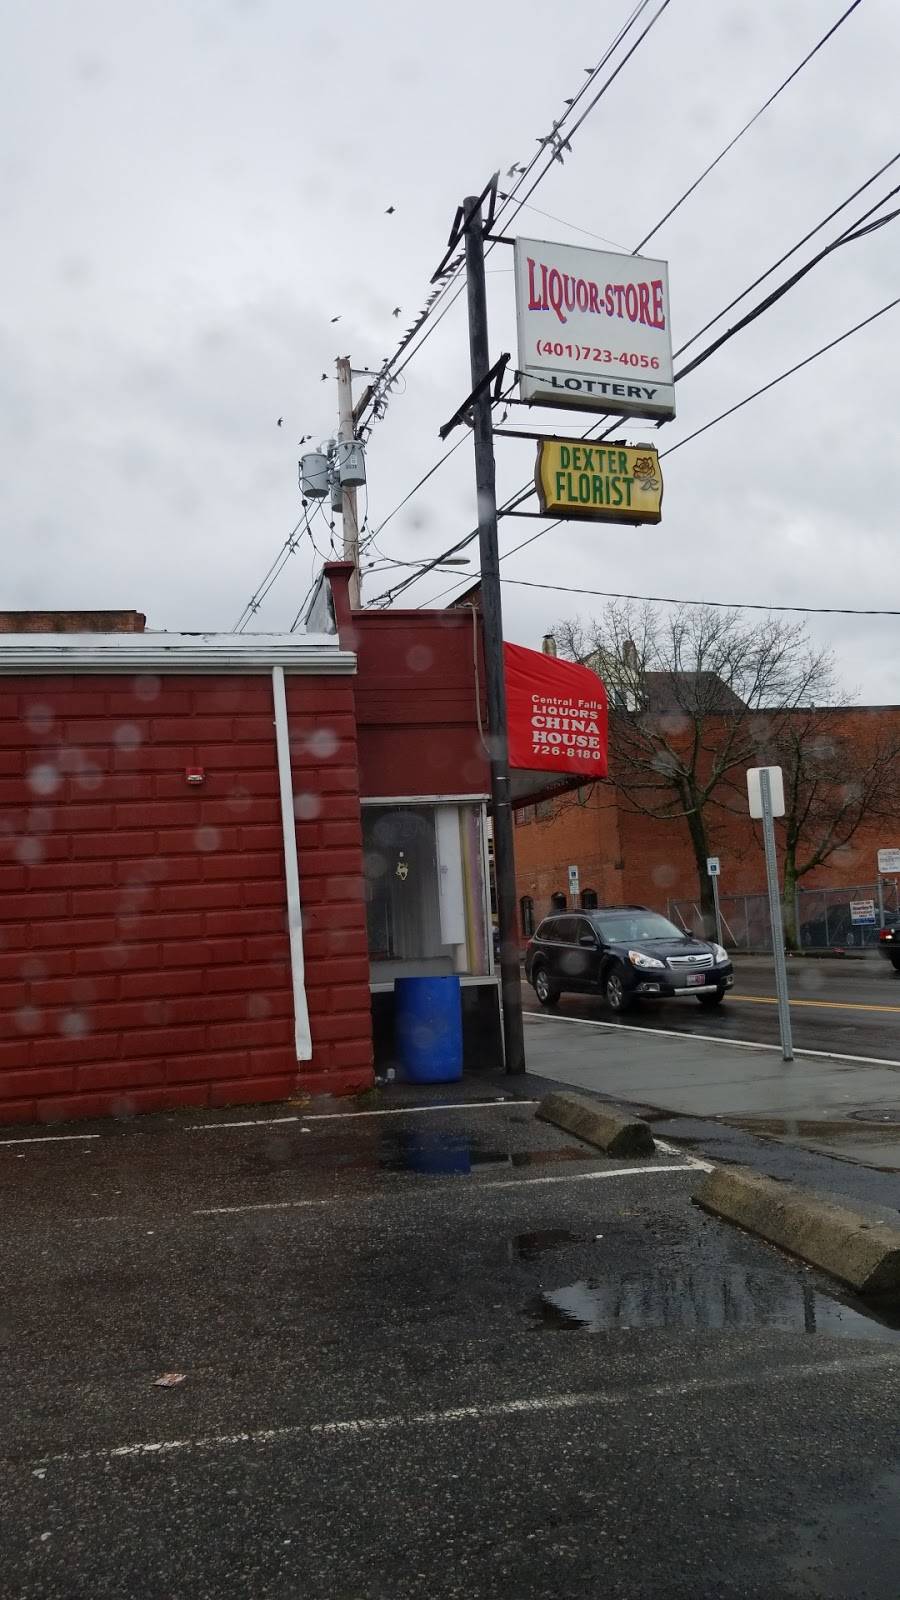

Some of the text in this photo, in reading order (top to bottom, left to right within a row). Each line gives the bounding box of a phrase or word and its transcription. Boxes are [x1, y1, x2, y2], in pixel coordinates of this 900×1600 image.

[536, 340, 660, 370] (401)723-4056
[552, 376, 658, 400] LOTTERY
[560, 446, 628, 475] DEXTER
[556, 472, 634, 507] FLORIST
[531, 694, 602, 710] Central Falls
[532, 705, 598, 719] LIQUORS
[531, 715, 600, 734] CHINA
[532, 731, 600, 749] HOUSE
[532, 744, 600, 760] 726-8180
